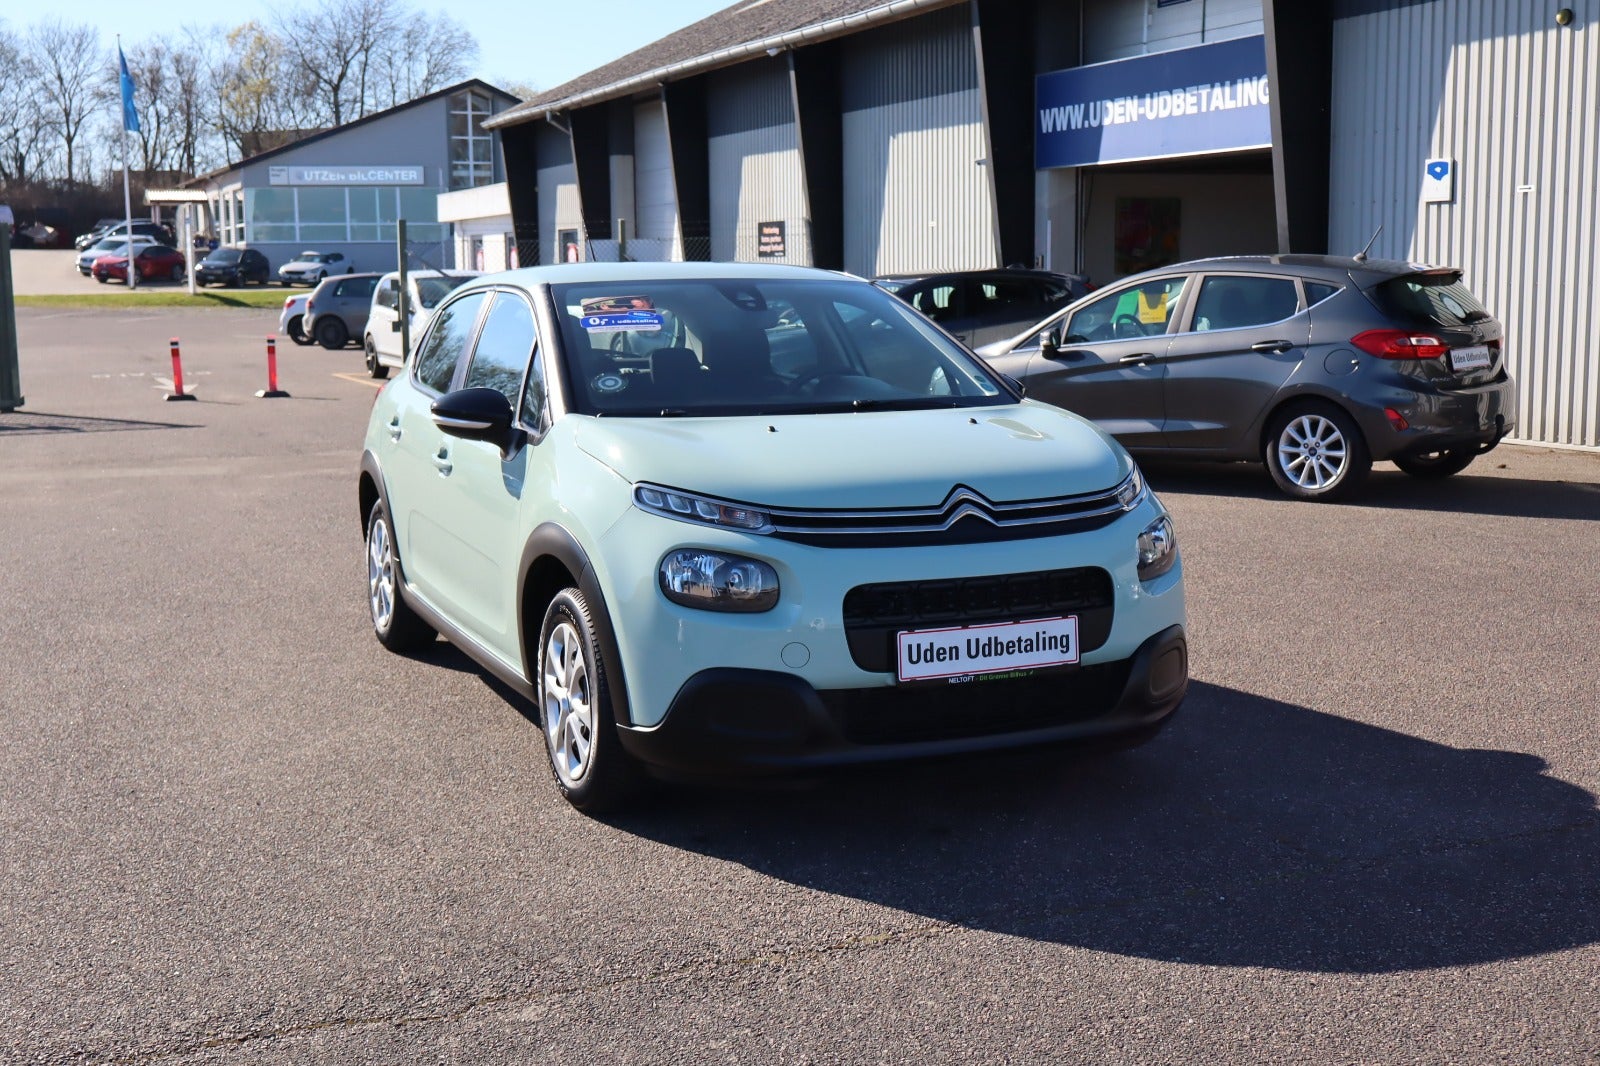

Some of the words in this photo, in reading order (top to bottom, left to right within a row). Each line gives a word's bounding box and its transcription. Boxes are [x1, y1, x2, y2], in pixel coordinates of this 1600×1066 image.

[1040, 74, 1270, 134] WWW.UDEN-UDBETALING
[907, 641, 960, 665] Uden
[966, 630, 1071, 660] Udbetaling
[948, 675, 975, 684] NELTOFT
